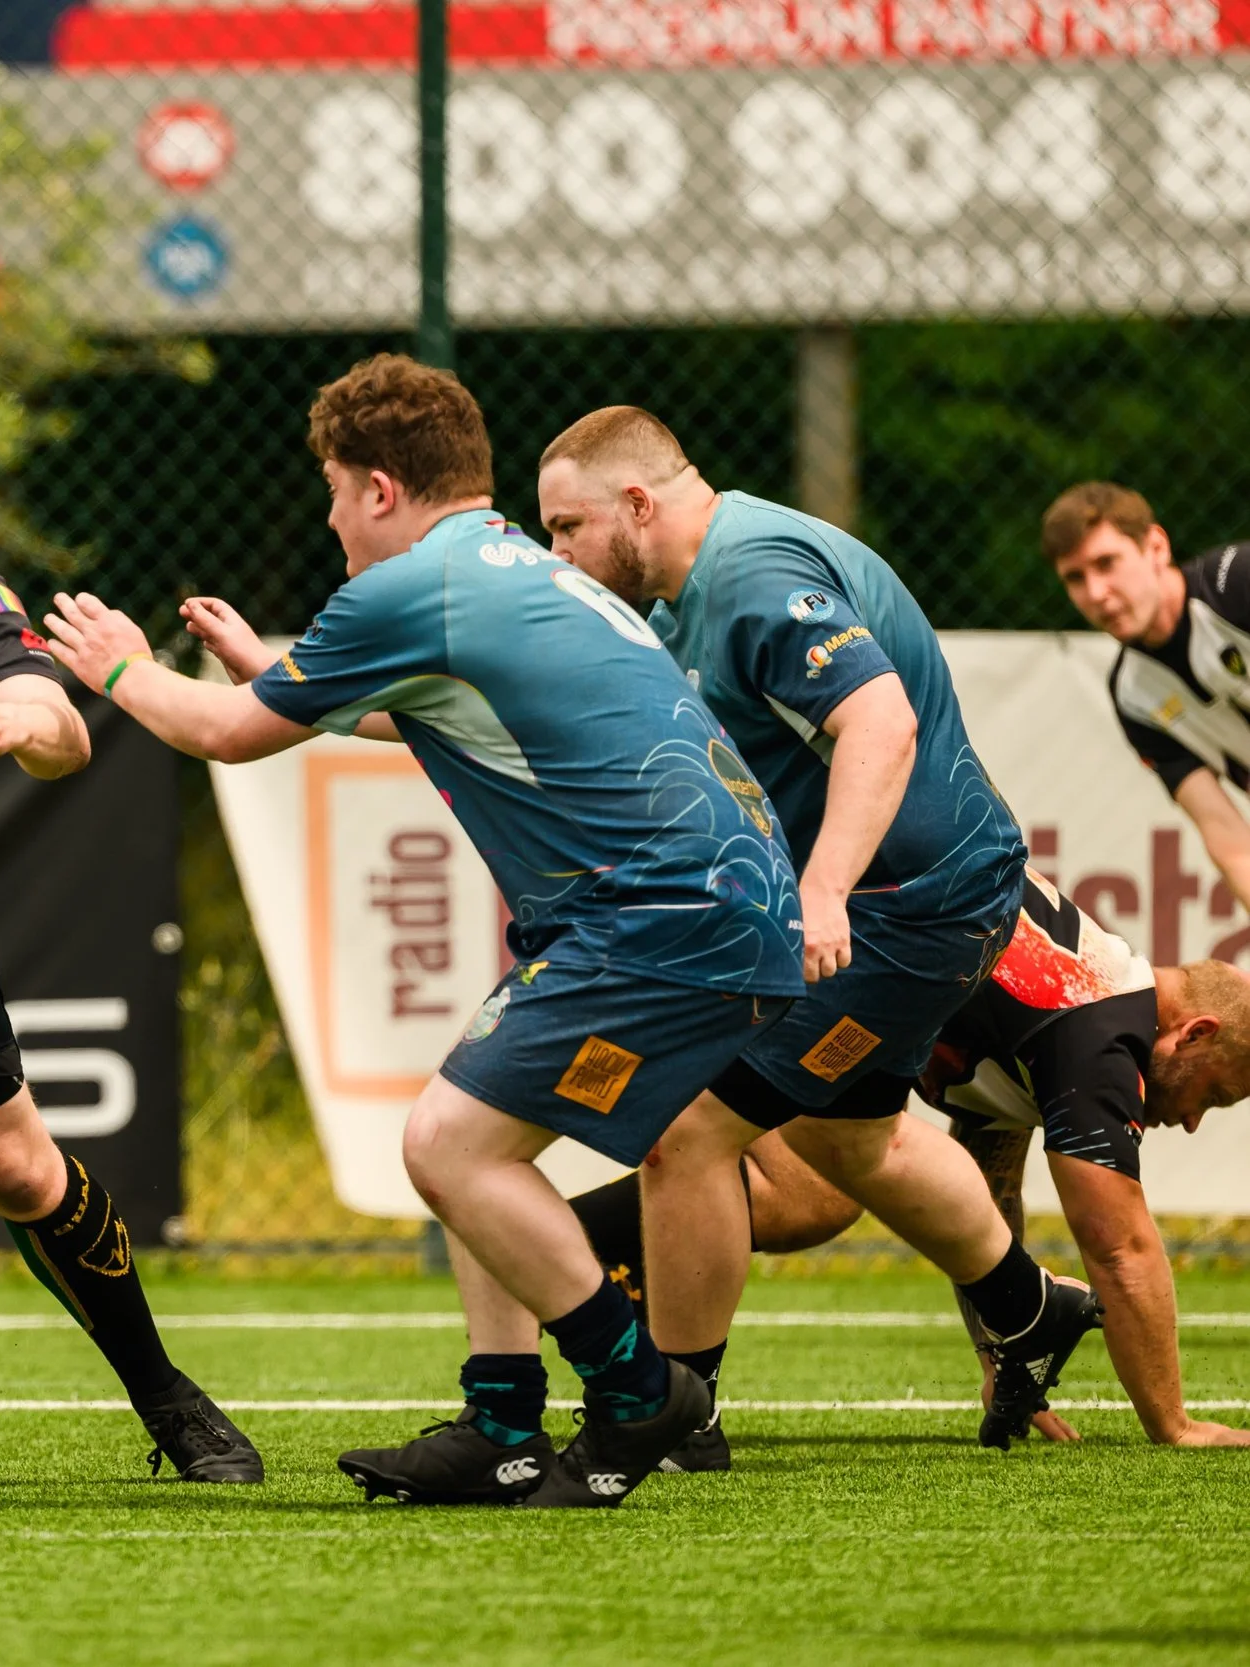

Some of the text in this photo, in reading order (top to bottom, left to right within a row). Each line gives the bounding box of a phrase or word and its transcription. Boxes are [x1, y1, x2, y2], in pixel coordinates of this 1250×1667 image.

[300, 82, 690, 240] 800
[789, 592, 828, 622] MFV
[365, 830, 455, 1019] radio
